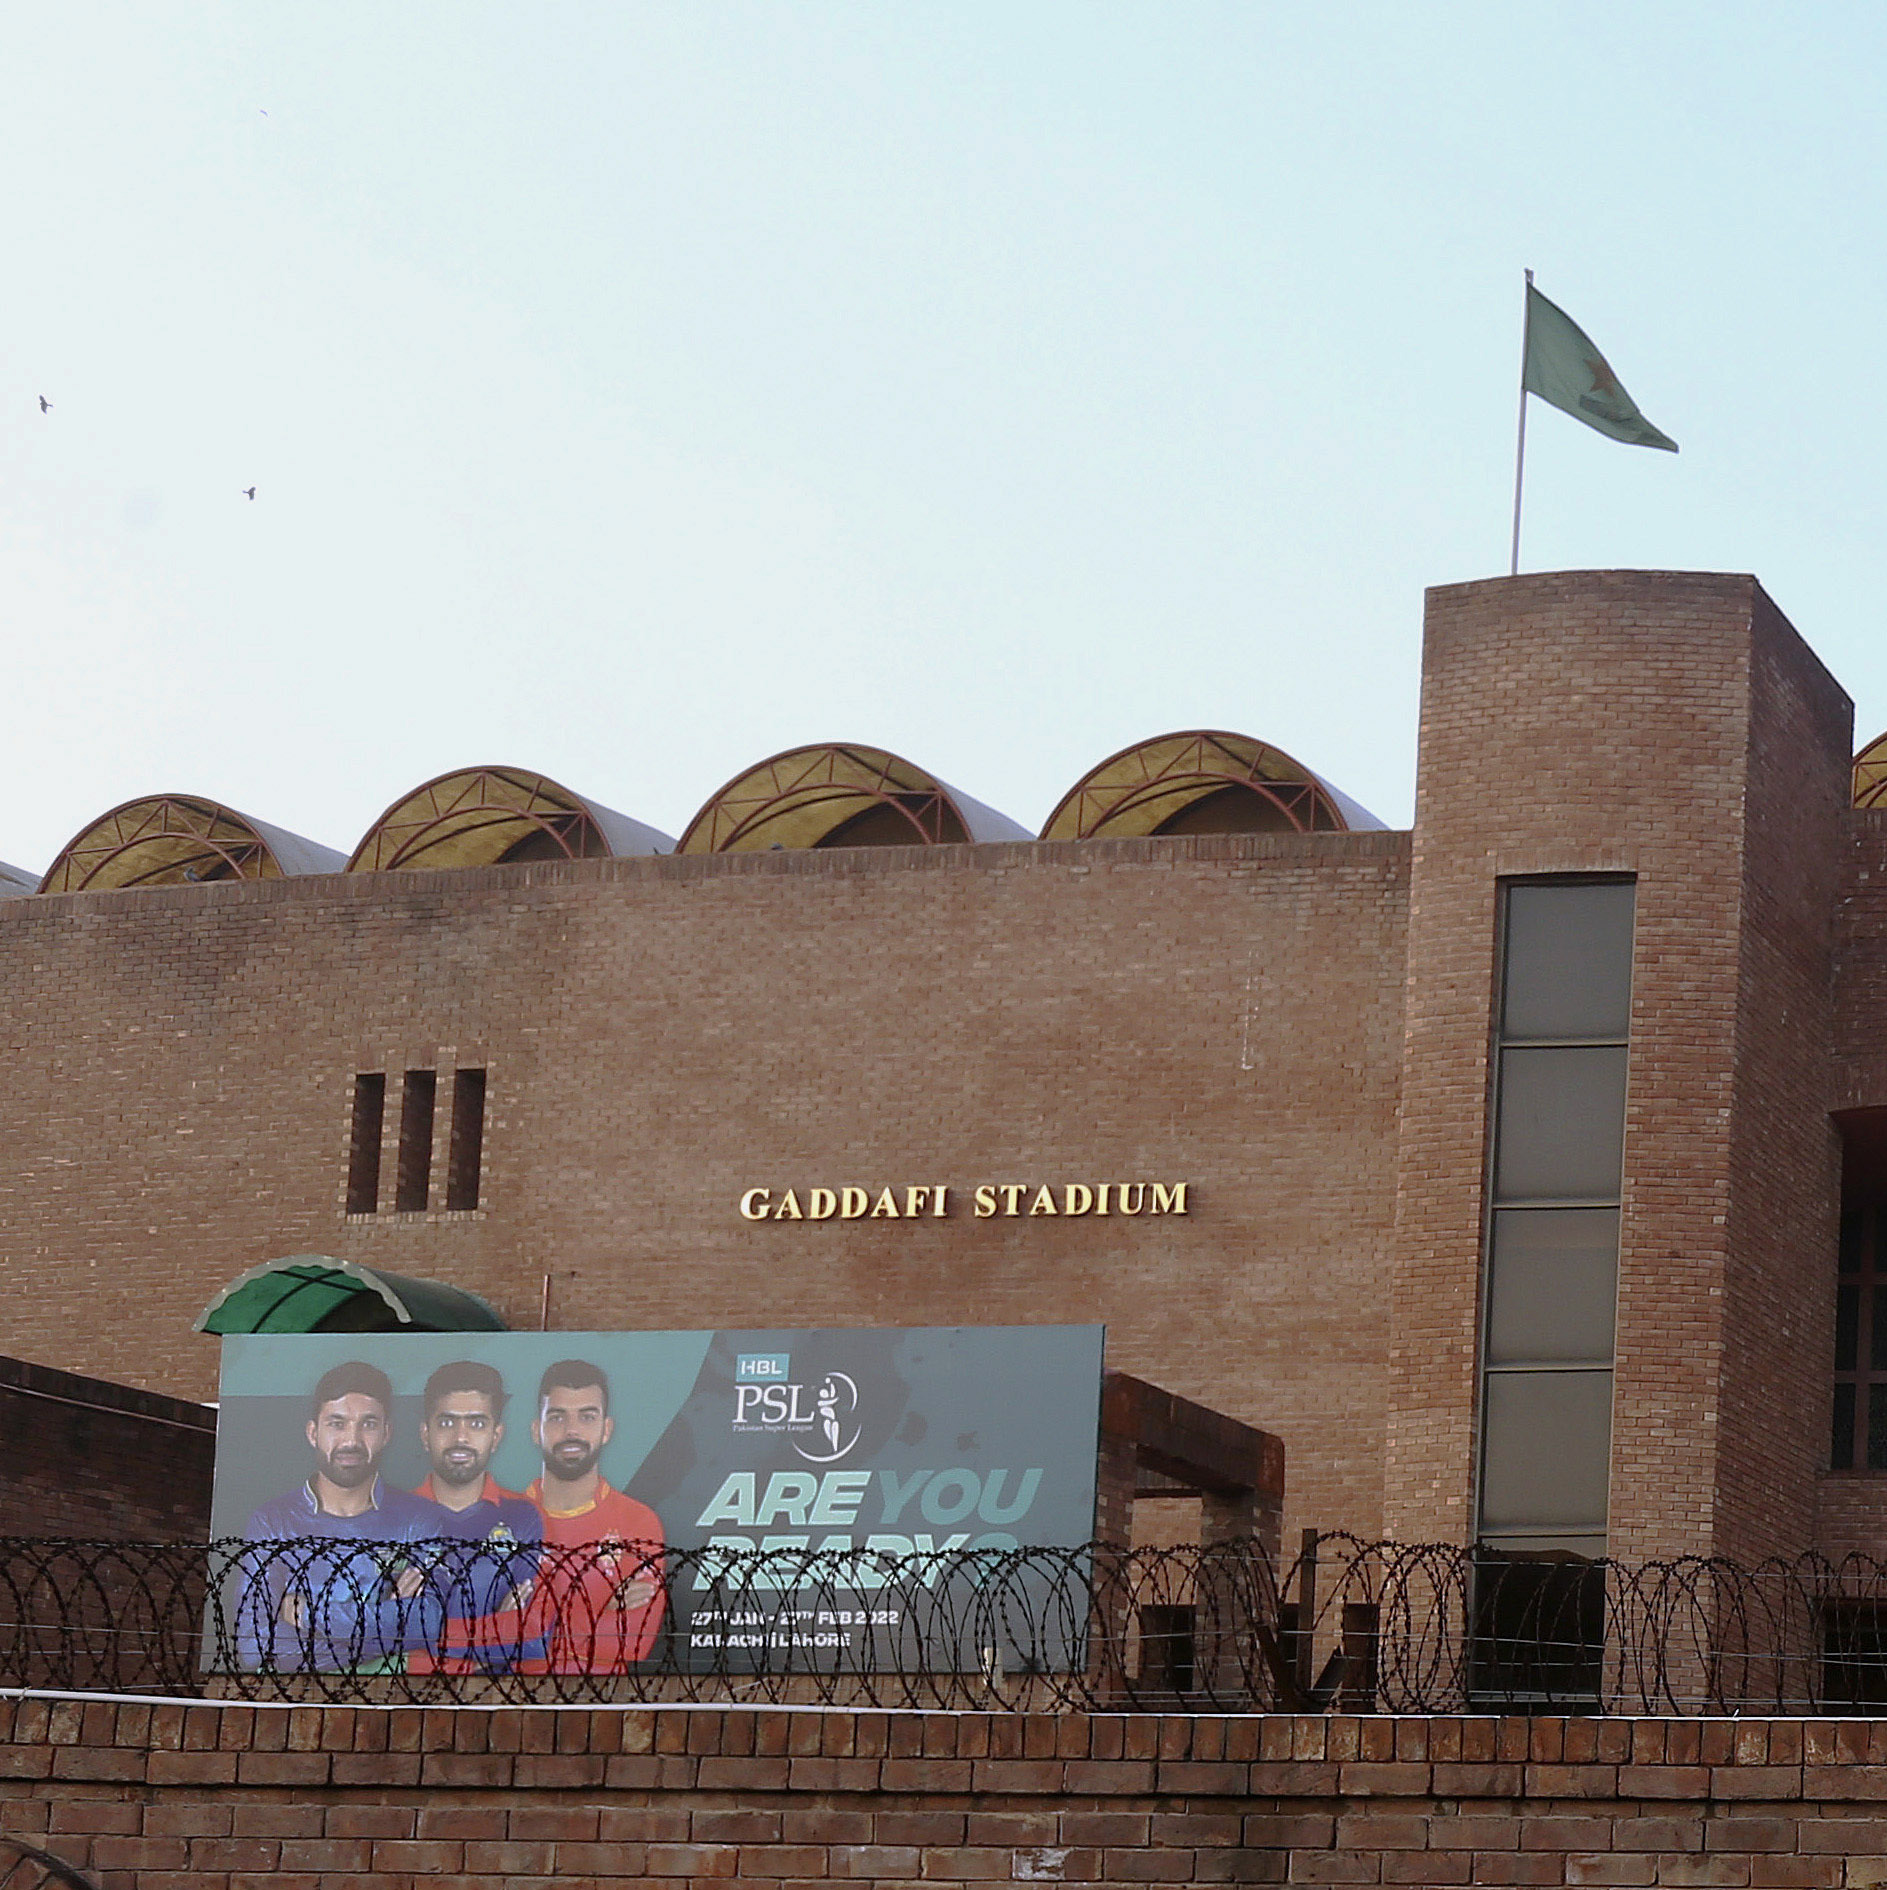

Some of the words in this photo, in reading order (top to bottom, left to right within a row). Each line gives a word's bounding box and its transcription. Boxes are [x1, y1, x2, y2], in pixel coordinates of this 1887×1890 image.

[739, 1186, 949, 1222] GADDAFI
[973, 1182, 1190, 1217] STADIUM
[741, 1360, 783, 1375] HBL
[732, 1384, 816, 1424] PSL
[694, 1470, 873, 1527] ARE
[878, 1467, 1044, 1526] YOU
[818, 1611, 852, 1626] FEB
[855, 1611, 899, 1626] 2022
[779, 1632, 851, 1648] LAHORE
